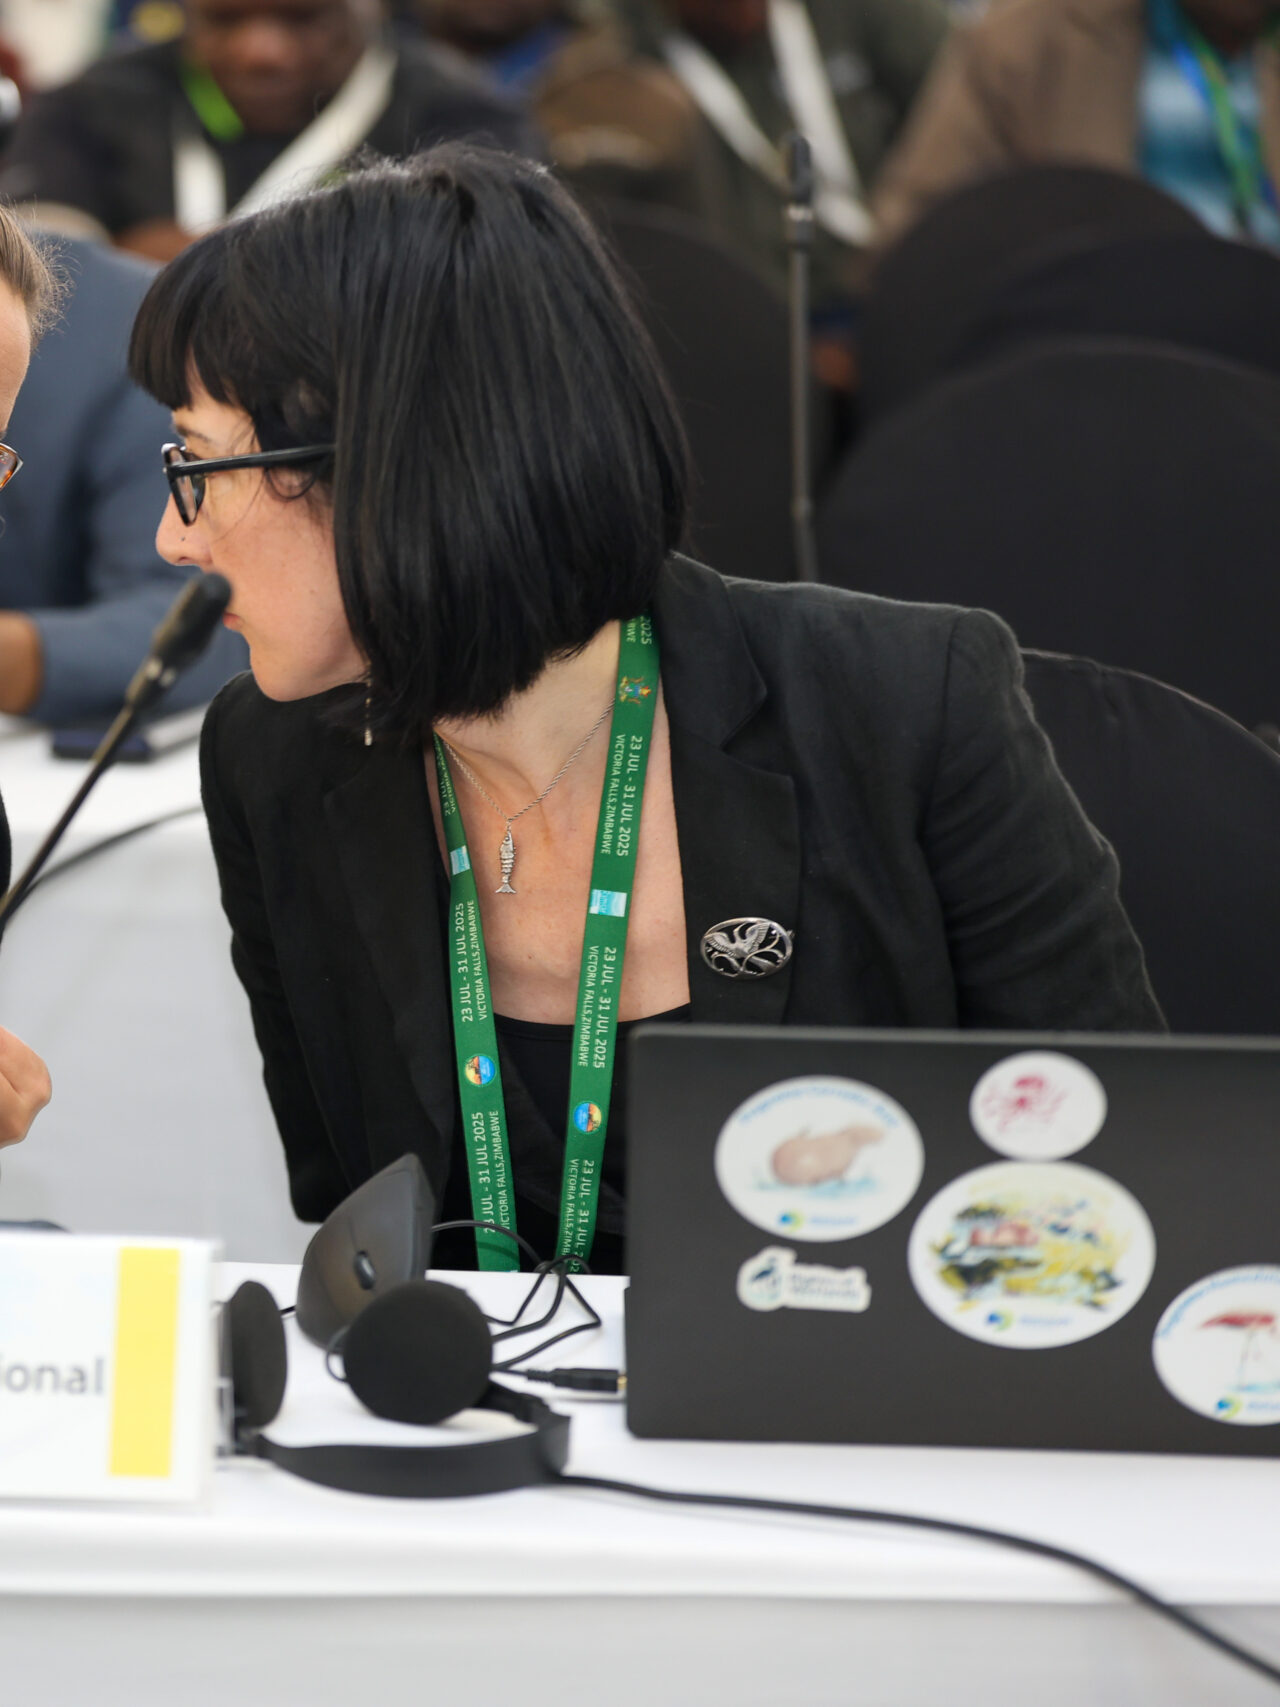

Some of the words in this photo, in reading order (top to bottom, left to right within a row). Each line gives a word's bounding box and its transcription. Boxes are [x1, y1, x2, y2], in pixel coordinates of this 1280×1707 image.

[630, 735, 643, 750] 23
[611, 734, 626, 776] VICTORIA
[626, 752, 641, 774] JUL
[623, 784, 636, 799] 31
[620, 802, 634, 824] JUL
[616, 826, 631, 857] 2025
[455, 902, 465, 933] 2025
[455, 934, 467, 956] JUL
[603, 946, 617, 962] 23
[457, 958, 469, 974] 31
[585, 945, 600, 987] VICTORIA
[600, 964, 615, 986] JUL
[459, 983, 472, 1005] JUL
[474, 977, 488, 1021] VICTORIA
[598, 996, 612, 1011] 31
[461, 1007, 474, 1023] 23
[594, 1014, 610, 1036] JUL
[592, 1038, 608, 1069] 2025
[471, 1111, 486, 1142] 2025
[476, 1144, 489, 1166] JUL
[478, 1168, 491, 1184] 31
[581, 1159, 595, 1174] 23
[567, 1158, 580, 1200] VICTORIA
[578, 1176, 593, 1198] JUL
[480, 1194, 494, 1216] JUL
[577, 1209, 590, 1224] 31
[574, 1227, 588, 1248] JUL
